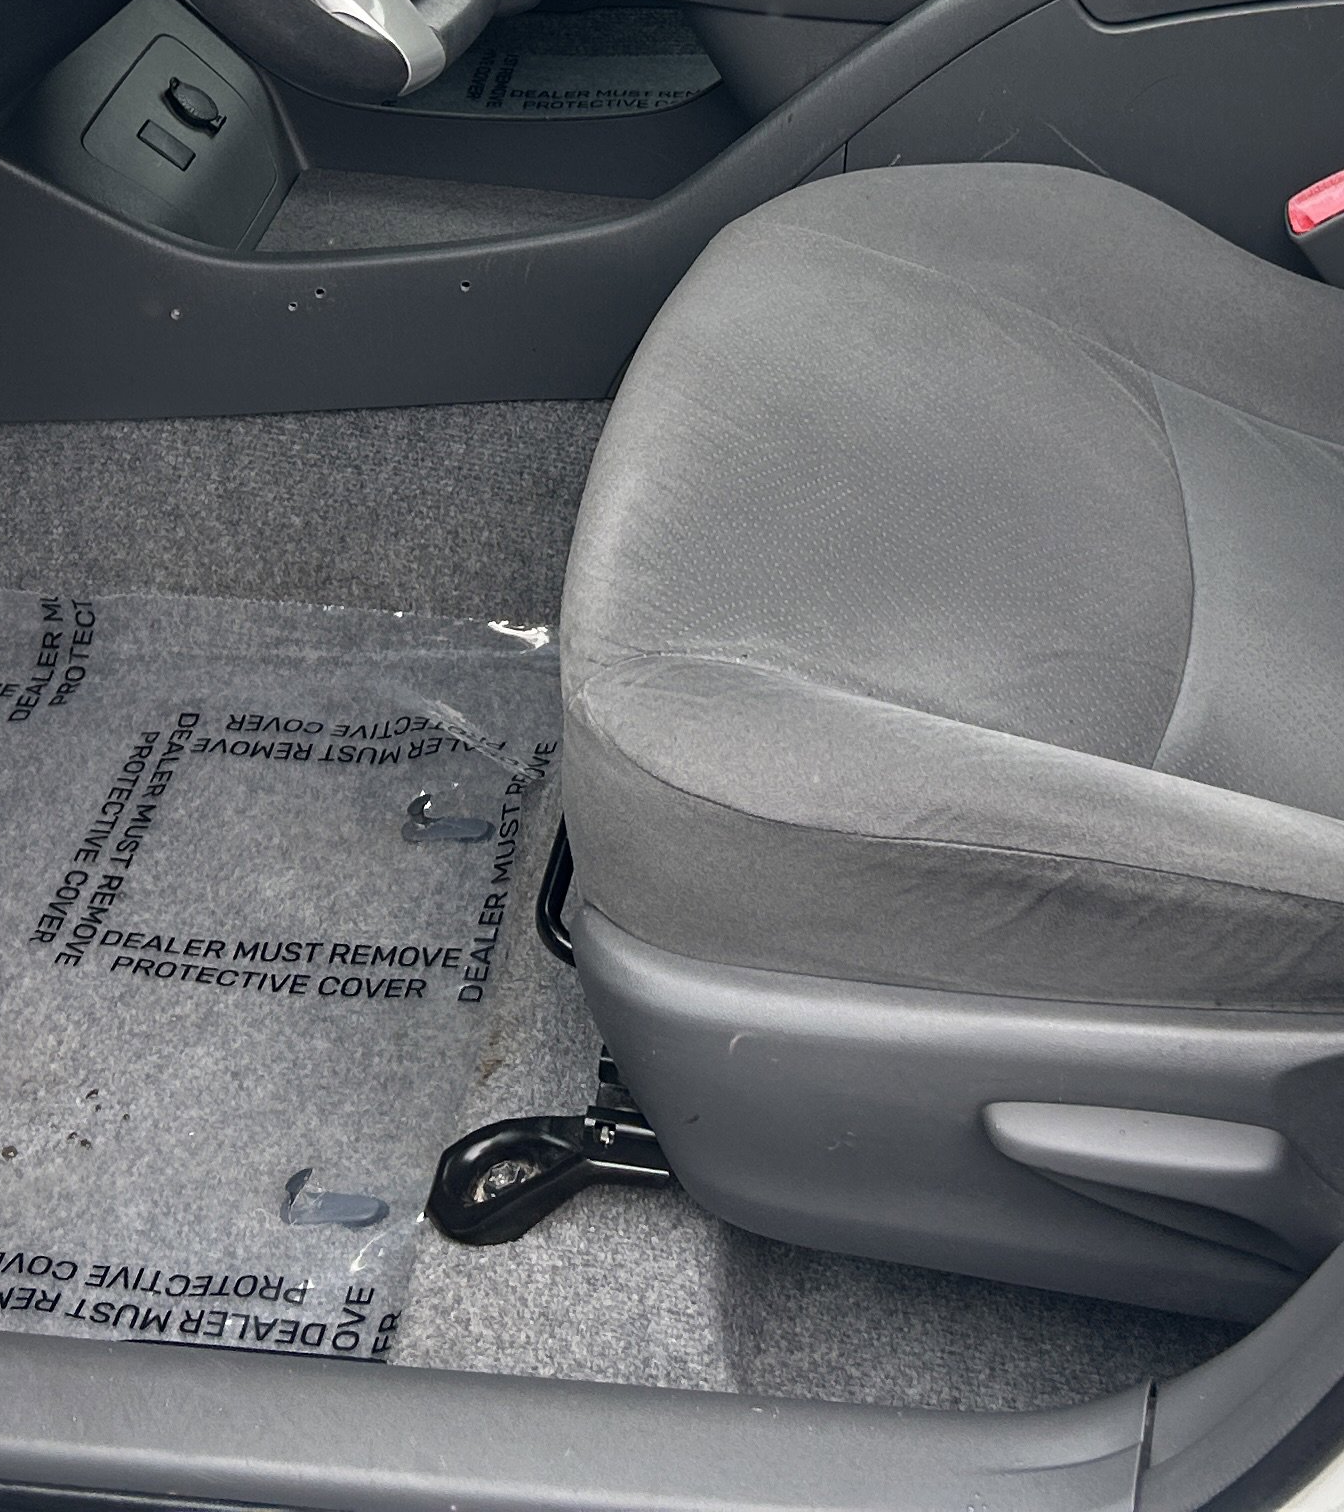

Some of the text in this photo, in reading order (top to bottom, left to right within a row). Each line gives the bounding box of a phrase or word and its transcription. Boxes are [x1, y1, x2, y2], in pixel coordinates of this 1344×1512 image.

[510, 89, 590, 99] DEALER
[595, 89, 653, 98] MUST
[523, 99, 649, 109] PROTECTIVE
[8, 631, 63, 722] DEALER
[225, 713, 324, 734] COVER
[190, 737, 314, 762] REMOVE
[317, 744, 402, 765] MUST
[29, 730, 160, 944] PROTECTIVE COVER
[54, 712, 200, 967] DEALER MUST REMOVE
[457, 891, 507, 1003] DEALER
[491, 803, 521, 887] MUST
[100, 929, 463, 969] DEALER MUST REMOVE
[110, 955, 428, 999] PROTECTIVE COVER
[85, 1263, 311, 1304] PROTECTIVE
[64, 1298, 172, 1334] MUST
[178, 1309, 327, 1345] DEALER
